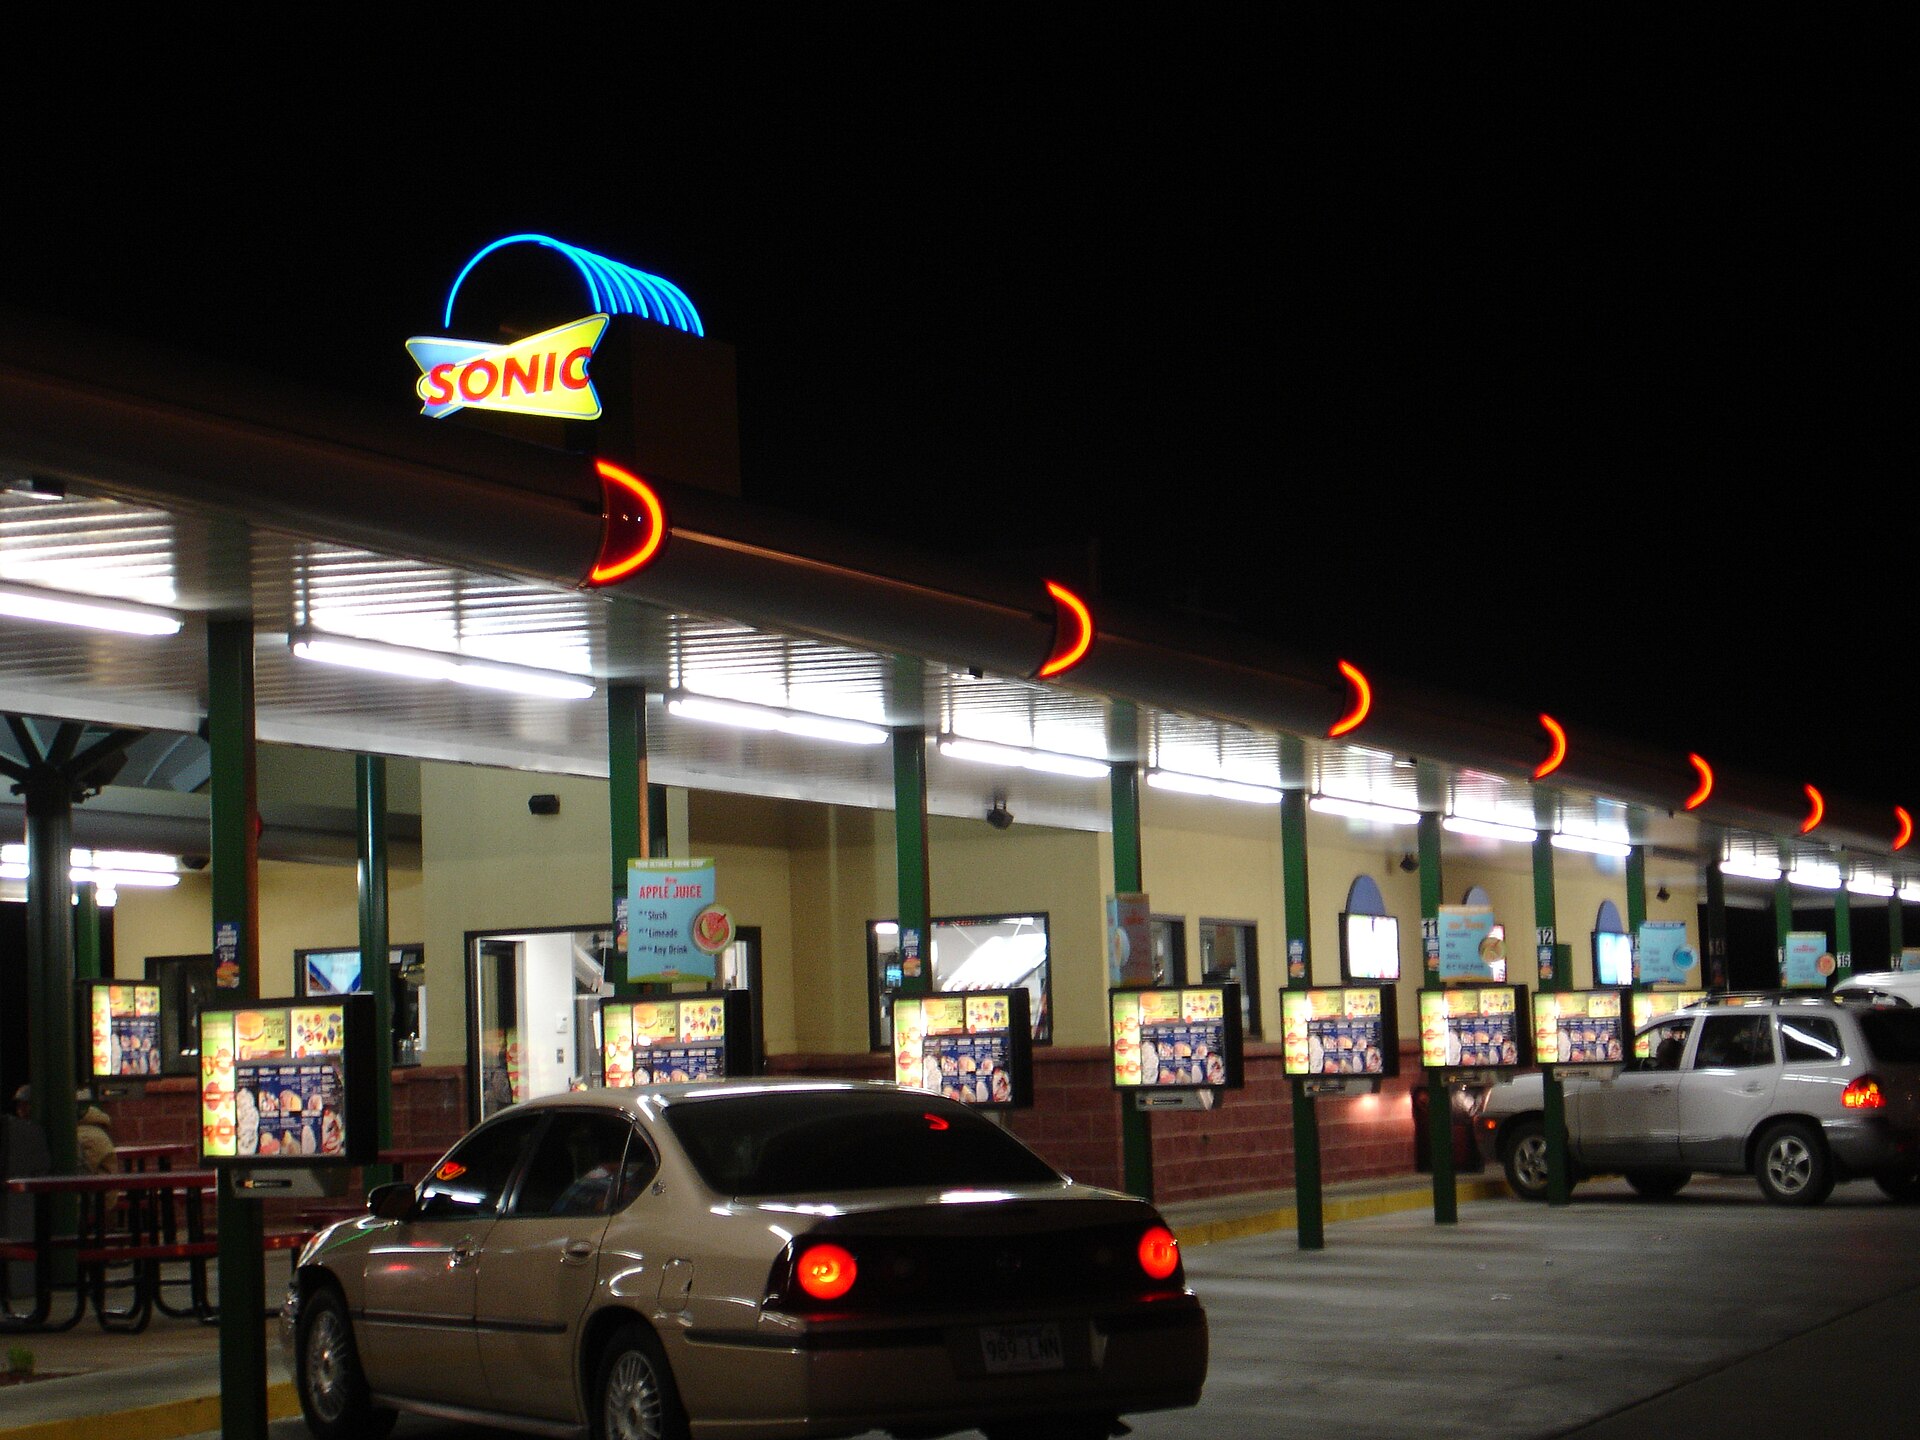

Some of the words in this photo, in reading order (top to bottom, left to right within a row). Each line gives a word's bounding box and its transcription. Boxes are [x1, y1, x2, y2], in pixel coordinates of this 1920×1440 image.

[424, 346, 593, 407] SONIC
[639, 885, 670, 899] APPLE
[673, 885, 702, 899] JUICE
[648, 910, 668, 921] Slush
[648, 928, 678, 938] Limeade
[1424, 920, 1438, 938] 11
[1538, 928, 1552, 945] 12
[654, 945, 667, 956] Any
[668, 945, 688, 955] Drink
